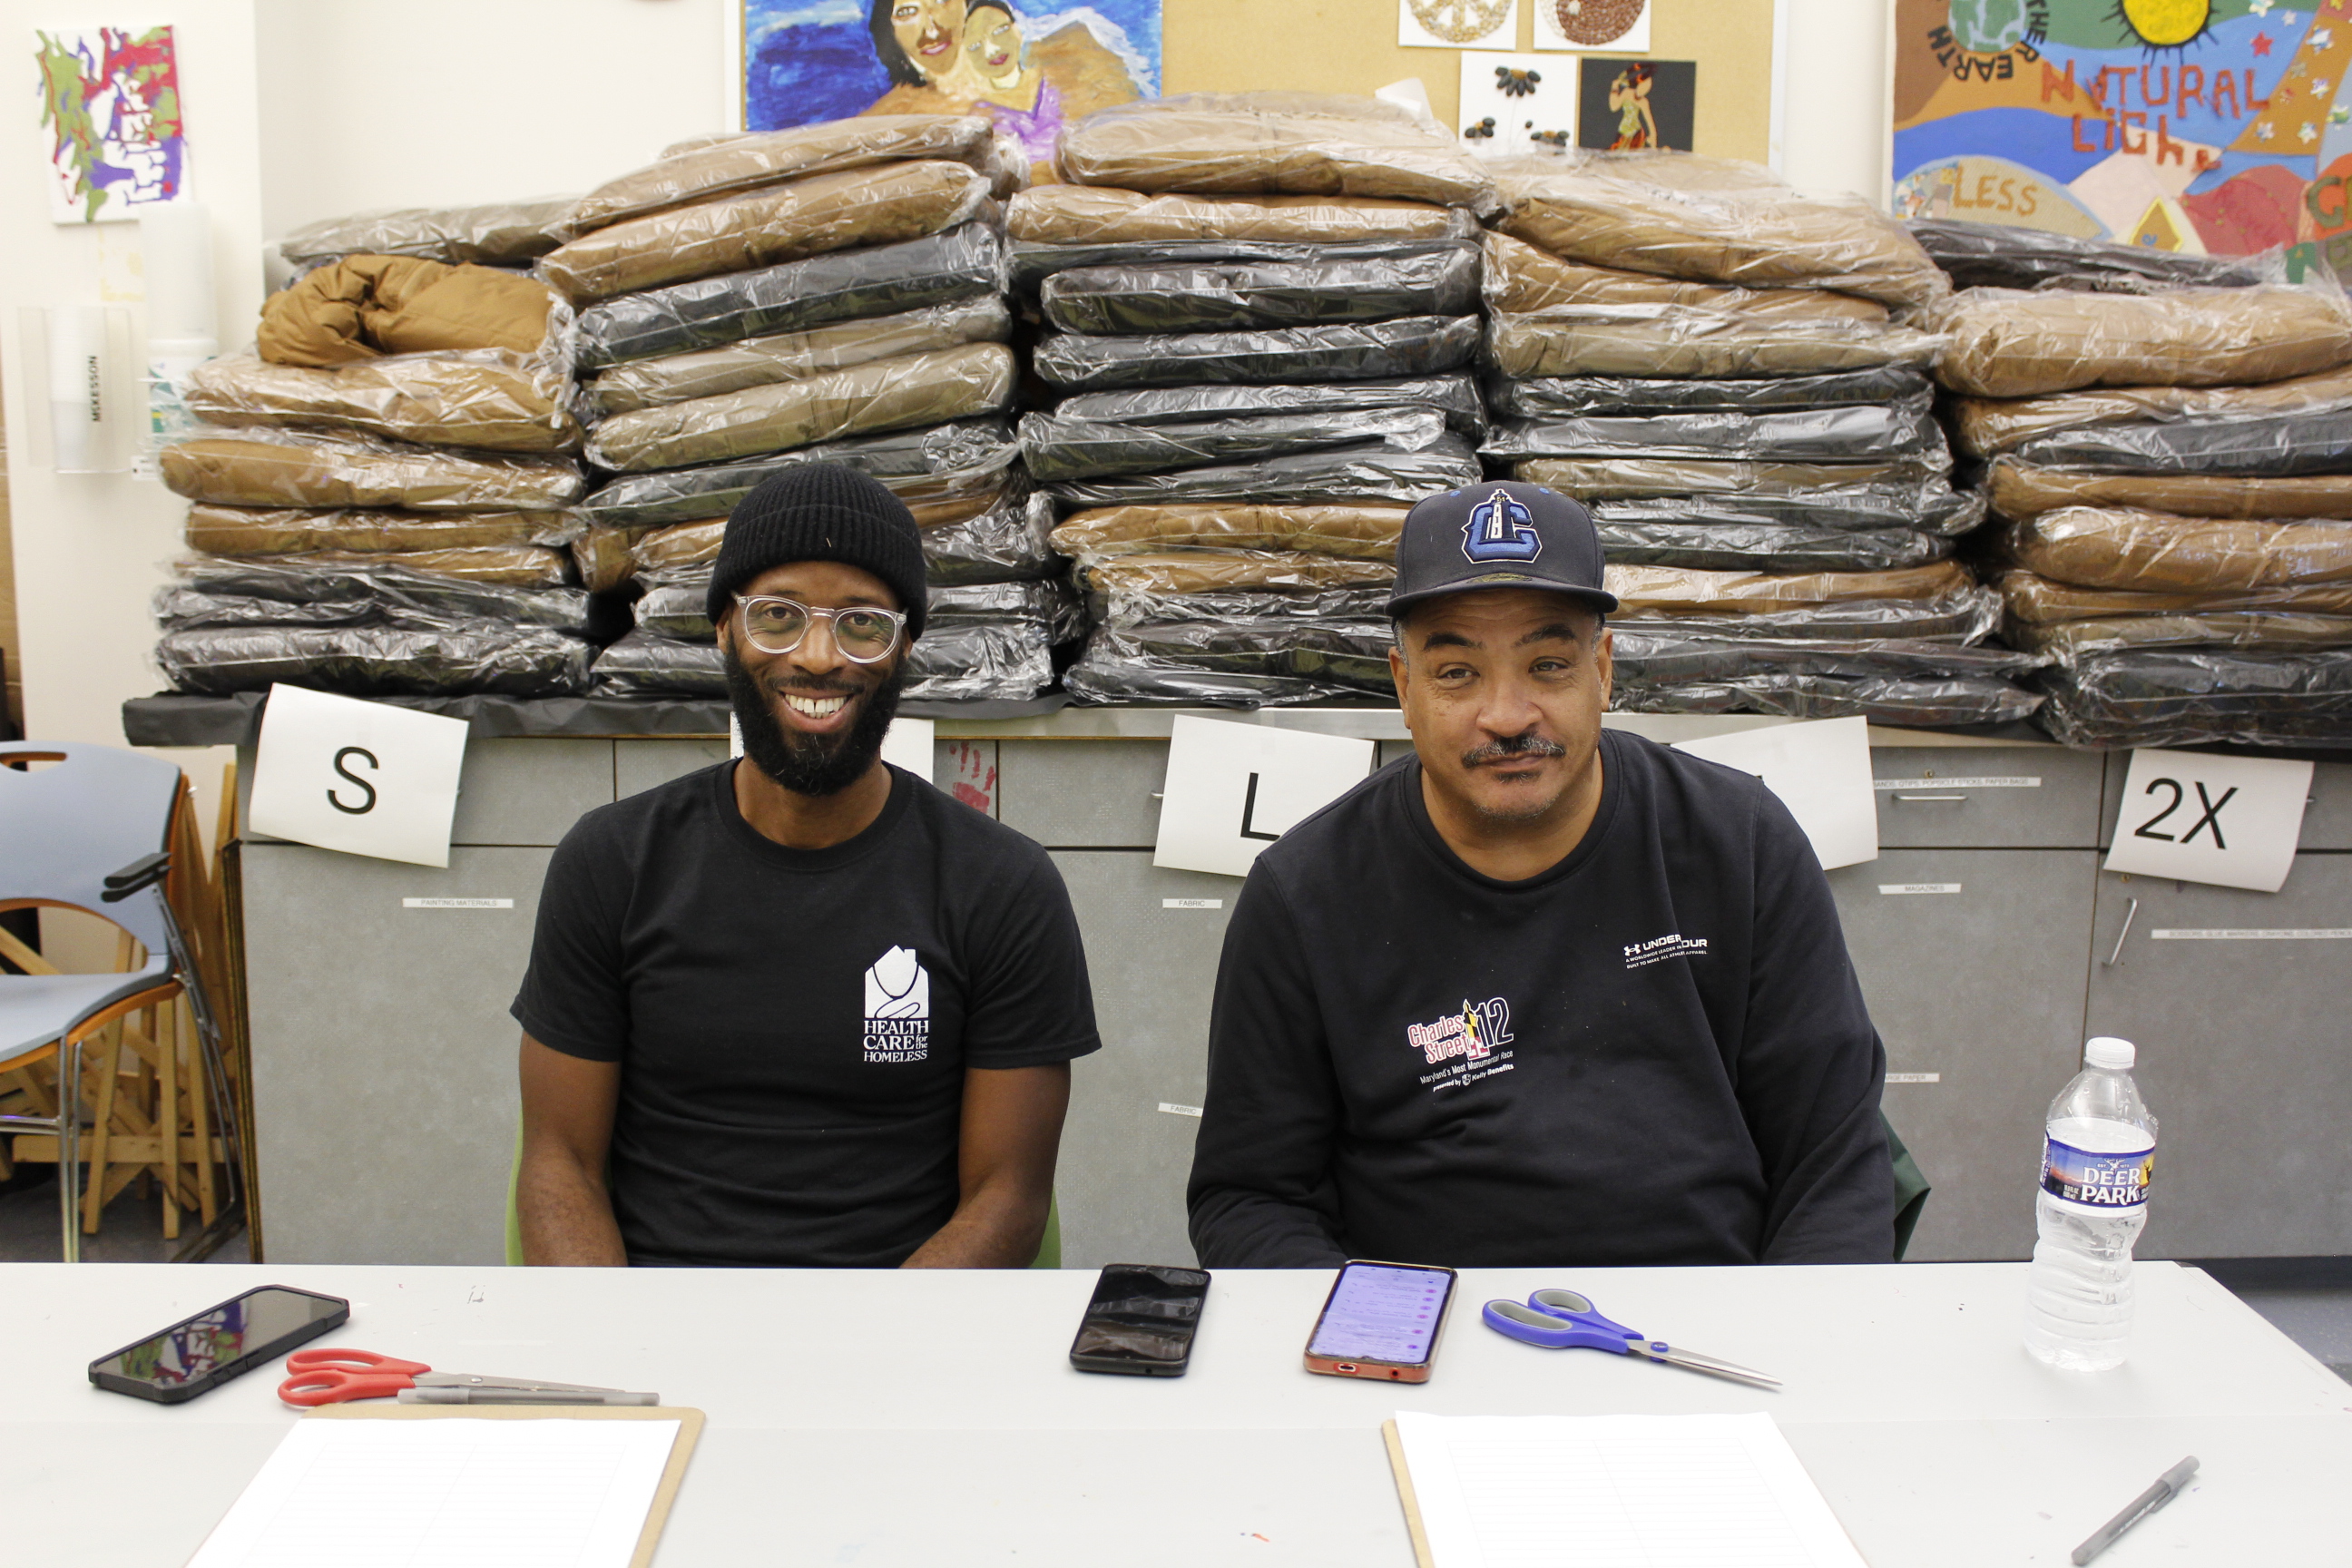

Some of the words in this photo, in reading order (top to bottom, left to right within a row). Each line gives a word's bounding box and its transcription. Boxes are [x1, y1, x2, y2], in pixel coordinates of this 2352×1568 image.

[1927, 25, 2014, 82] EARTH
[2042, 59, 2269, 119] NATURAL
[1954, 165, 2038, 217] LESS
[327, 746, 379, 815] S
[1240, 772, 1280, 841] L
[2134, 778, 2239, 849] 2X
[456, 899, 497, 907] MATERIALS
[1179, 899, 1205, 907] FABRIC
[1642, 934, 1681, 951] UNDER
[864, 1020, 929, 1034] HEALTH
[1407, 1015, 1465, 1047] Charles
[1474, 997, 1514, 1049] 12
[863, 1035, 915, 1050] CARE
[916, 1034, 928, 1043] for
[863, 1050, 927, 1063] HOMELESS
[1425, 1032, 1471, 1064] Street
[1419, 1068, 1452, 1085] Maryland's
[1451, 1063, 1467, 1074] Most
[1467, 1054, 1500, 1071] Monumental
[1500, 1050, 1514, 1061] Race
[1433, 1079, 1455, 1093] presented
[1455, 1078, 1462, 1086] by
[1472, 1071, 1487, 1082] Kelly
[1487, 1063, 1514, 1075] Benefits
[1171, 1105, 1197, 1115] FABRIC
[2082, 1167, 2141, 1185] DEER
[2080, 1184, 2140, 1205] PARK
